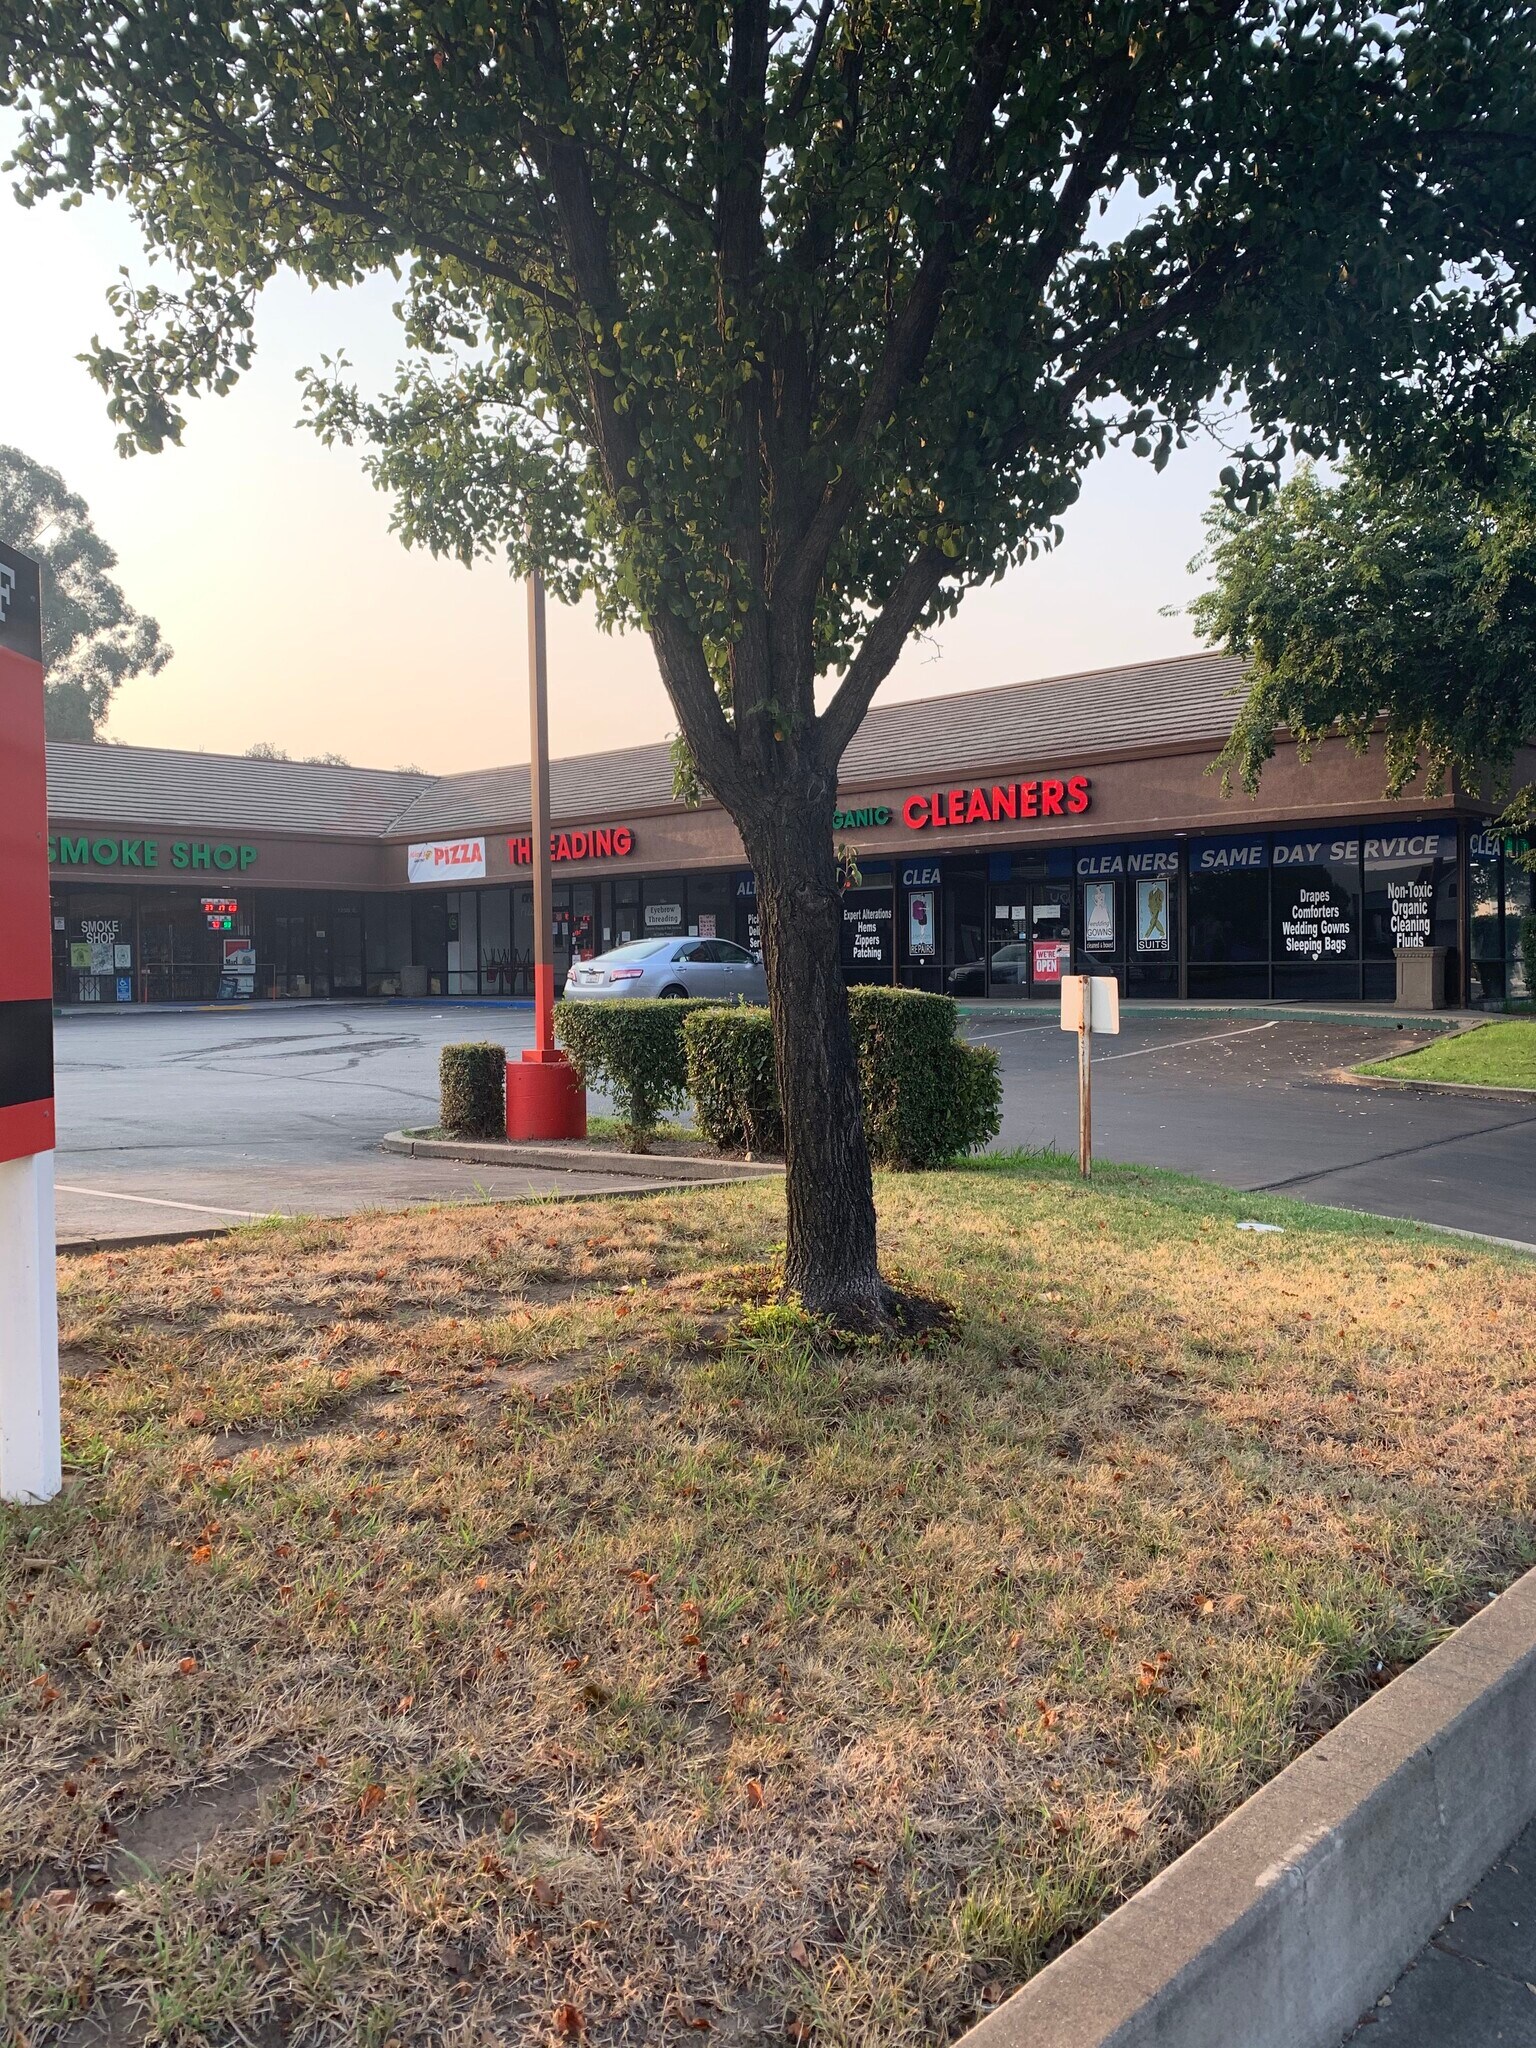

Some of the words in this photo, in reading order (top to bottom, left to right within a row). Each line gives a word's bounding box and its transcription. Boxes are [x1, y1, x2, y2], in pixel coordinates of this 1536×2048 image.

[833, 806, 889, 830] GANIC
[903, 775, 1088, 829] CLEANERS
[506, 826, 633, 865] THEADING
[1200, 847, 1262, 868] SAME
[1272, 843, 1321, 864] DAY
[1329, 835, 1440, 860] SERVICE
[172, 841, 257, 870] SHOP
[434, 842, 482, 866] PIZZA
[1076, 852, 1179, 875] CLEANERS
[1300, 889, 1330, 905] Drapes
[1387, 881, 1433, 899] Non-Toxic
[650, 906, 676, 915] Eyebrow
[843, 909, 861, 922] Expert
[862, 908, 892, 920] Alterations
[1292, 904, 1340, 919] Comforters
[1392, 898, 1428, 919] Organic
[81, 921, 119, 933] SMOKE
[648, 915, 678, 924] Threading
[857, 921, 877, 933] Hems
[1390, 915, 1431, 936] Cleaning
[1087, 928, 1112, 937] GOWNS
[1282, 921, 1318, 938] Wedding
[1320, 920, 1350, 934] Gowns
[86, 932, 115, 944] SHOP
[855, 934, 880, 947] Zippers
[1138, 940, 1168, 949] SUITS
[1286, 937, 1322, 954] Sleeping
[1324, 936, 1347, 953] Bags
[1396, 933, 1424, 948] Fluids
[853, 947, 882, 960] Patching
[910, 944, 934, 954] REPAIRS
[1037, 950, 1056, 958] WE'RE
[1036, 960, 1058, 973] OPEN
